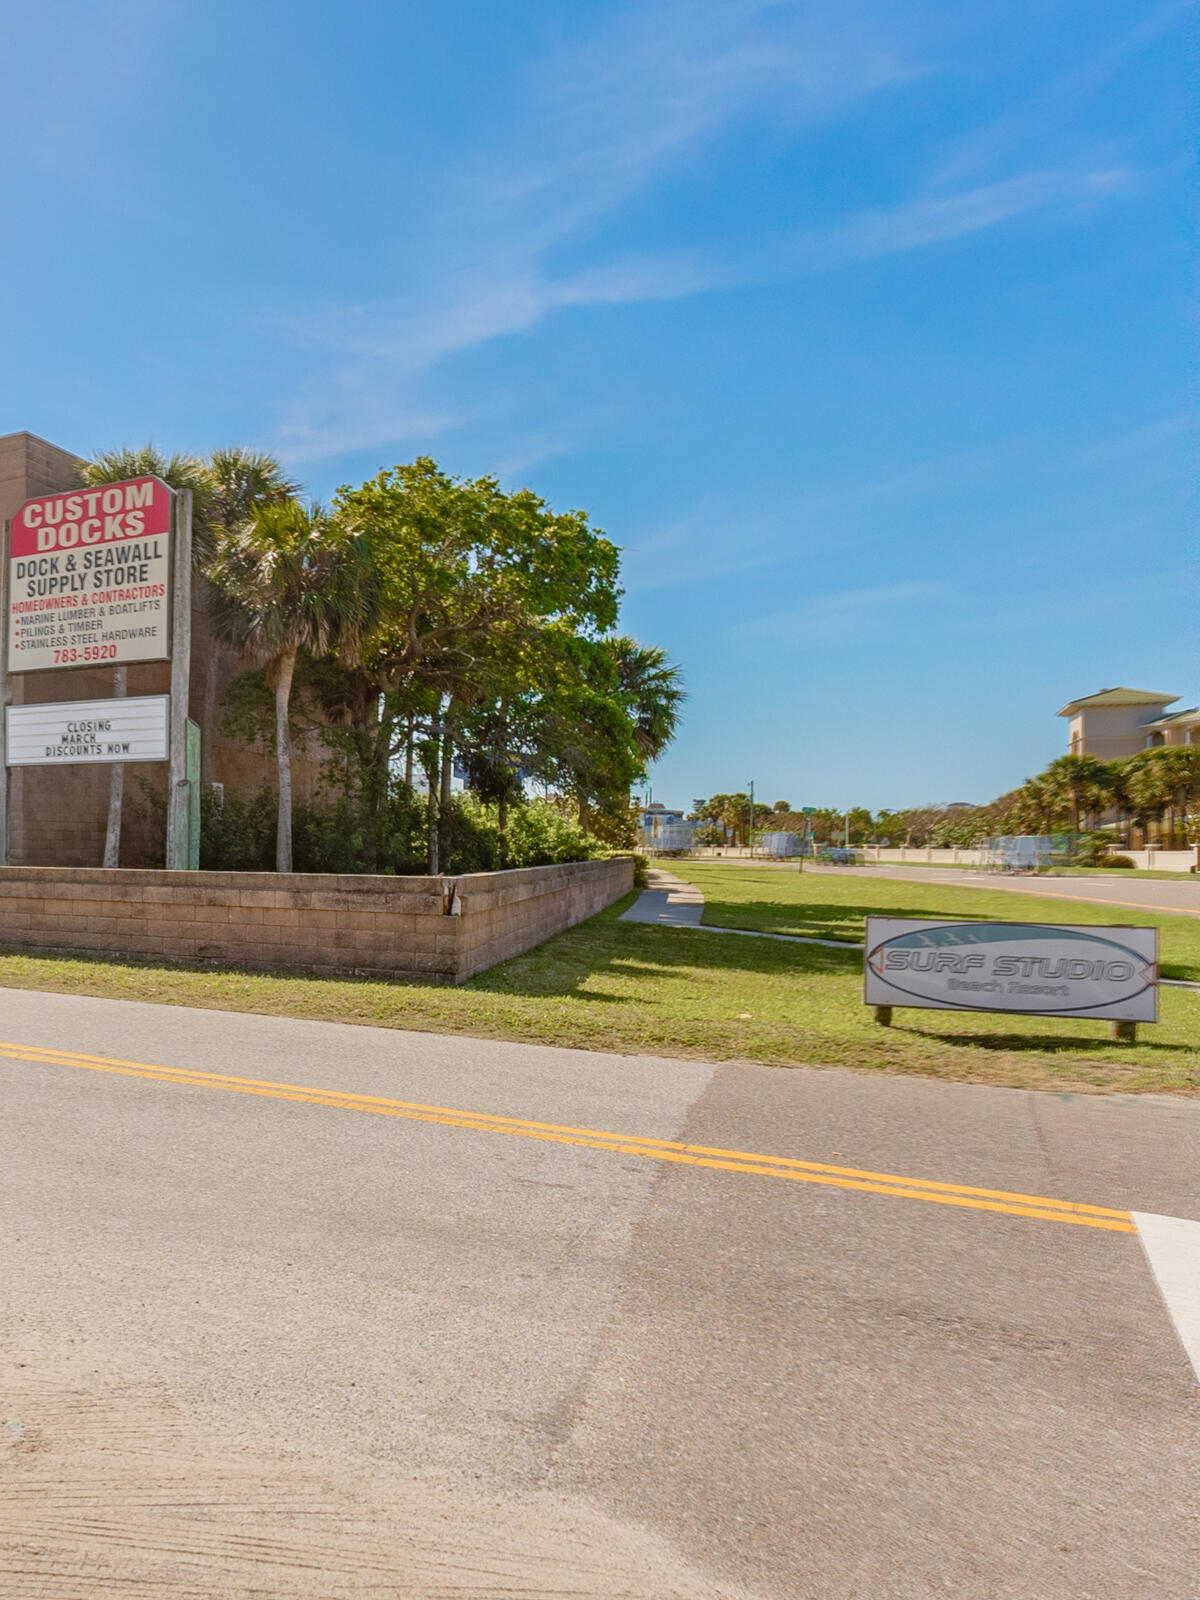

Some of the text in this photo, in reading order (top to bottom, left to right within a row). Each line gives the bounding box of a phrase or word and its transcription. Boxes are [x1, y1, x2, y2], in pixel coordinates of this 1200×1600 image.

[23, 482, 154, 528] CUSTOM
[37, 510, 145, 551] DOCKS
[16, 541, 162, 580] DOCK & SEAWALL
[27, 564, 149, 598] SUPPLY STORE
[11, 583, 166, 615] HOMEOWNERS & CONTRACTORS
[20, 599, 161, 626] MARINE LUMBER & BOATLIFTS
[20, 620, 104, 638] PILINGS & TIMBER
[20, 626, 157, 650] STAINLESS STEEL HARDWARE
[53, 644, 118, 664] 783-5920
[61, 733, 96, 745] MARCH
[67, 720, 112, 733] CLOSING
[45, 743, 130, 757] DISCOUNTS NOW
[885, 950, 1135, 982] SURF STUDIO
[947, 978, 1070, 997] Beach Resort
